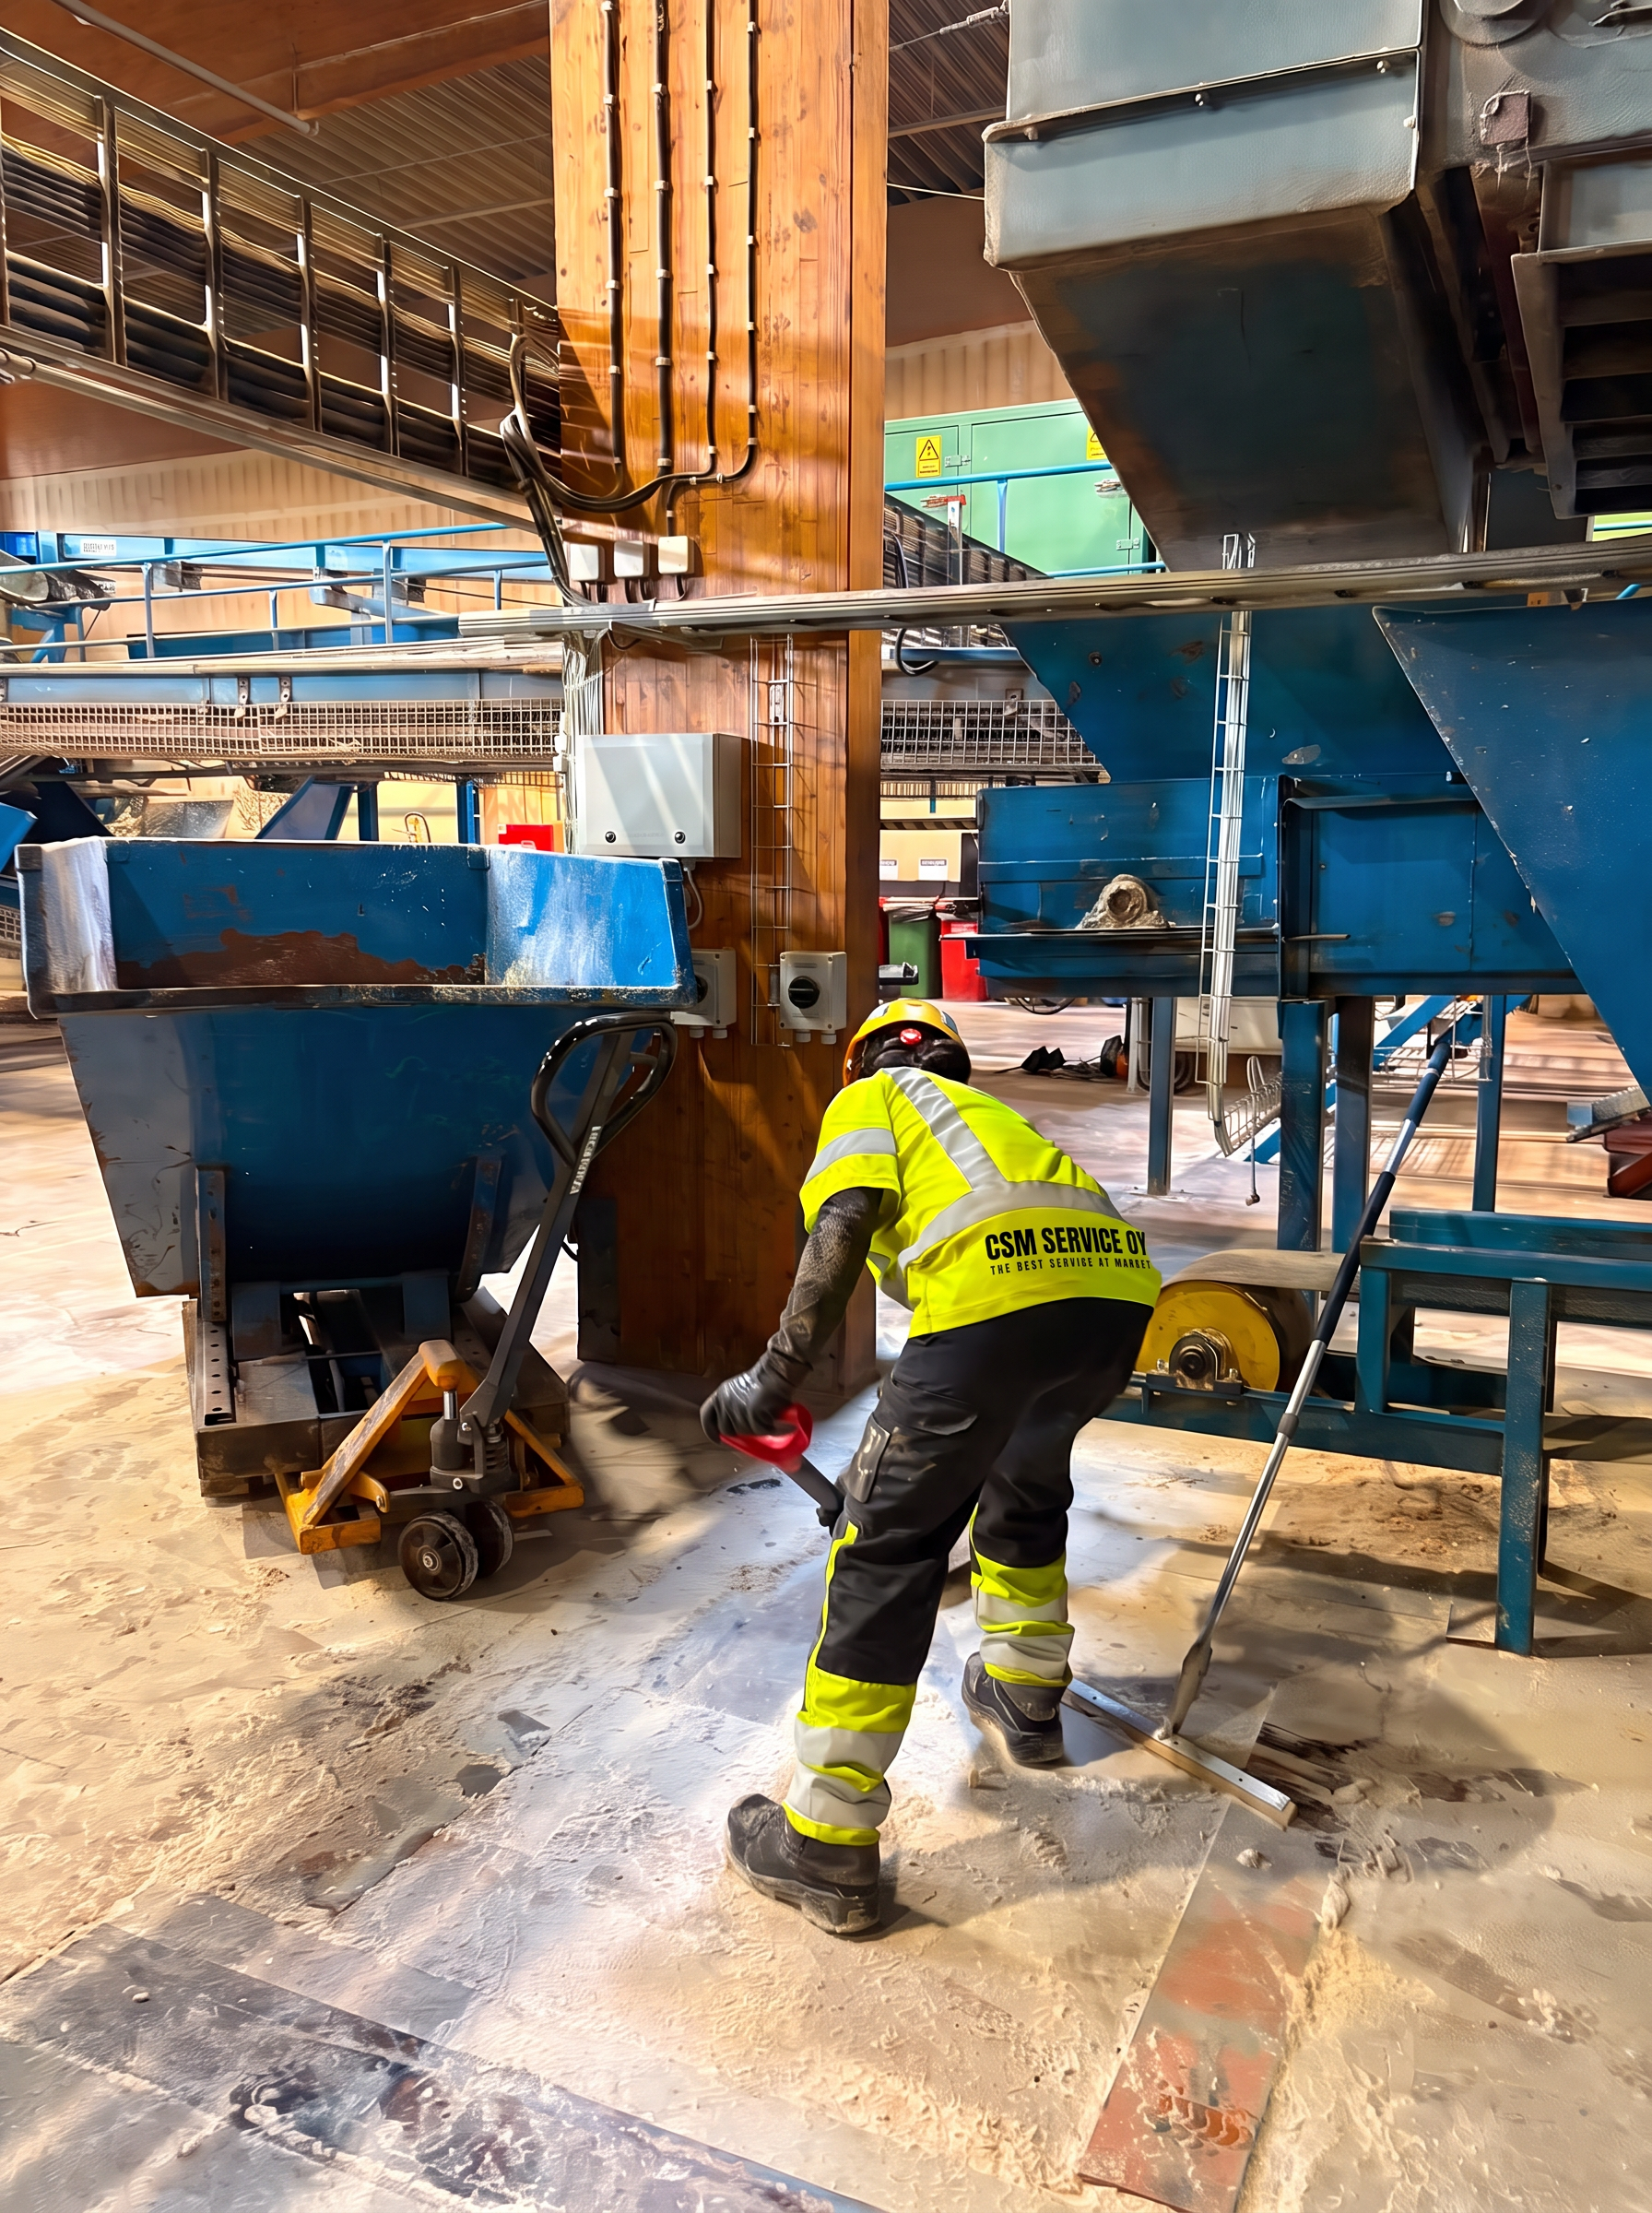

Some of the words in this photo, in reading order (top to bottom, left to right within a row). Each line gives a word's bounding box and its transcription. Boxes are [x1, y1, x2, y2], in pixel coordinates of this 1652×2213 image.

[985, 1228, 1038, 1260] CSM
[1041, 1226, 1124, 1255] SERVICE
[1126, 1230, 1147, 1256] OY
[990, 1262, 1011, 1276] THE
[1017, 1259, 1044, 1272] BEST
[1098, 1257, 1109, 1268] AT
